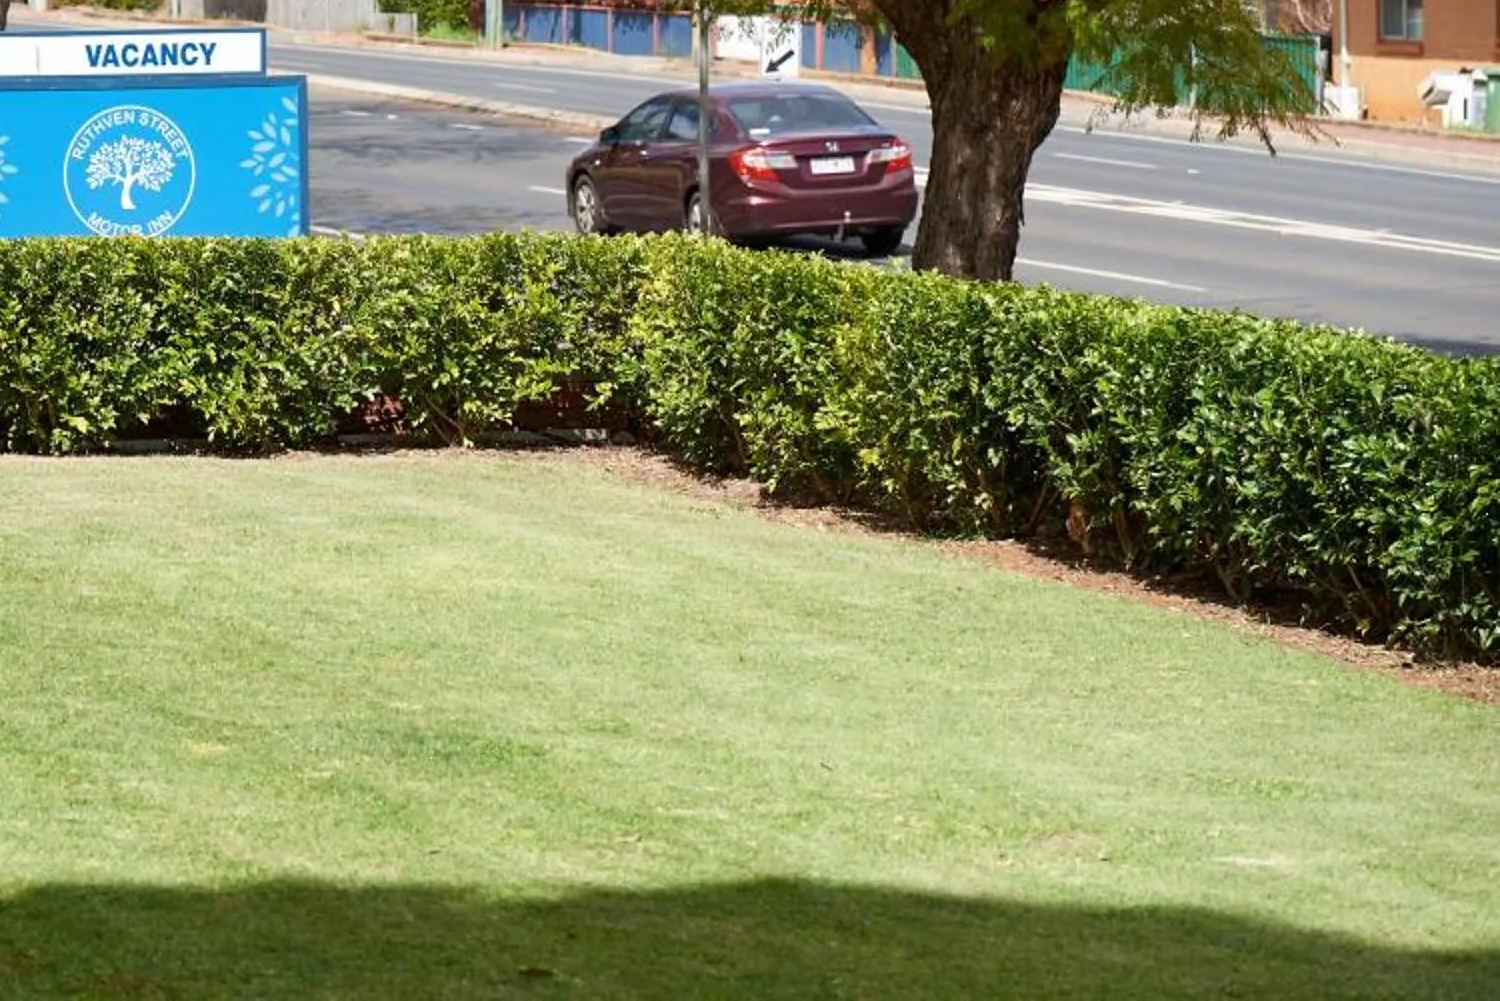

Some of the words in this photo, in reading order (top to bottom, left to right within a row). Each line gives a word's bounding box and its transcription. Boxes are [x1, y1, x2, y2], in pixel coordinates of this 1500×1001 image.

[84, 42, 218, 68] VACANCY
[71, 110, 135, 160] RUTHVEN
[139, 112, 190, 158] STREET
[147, 210, 173, 234] INN
